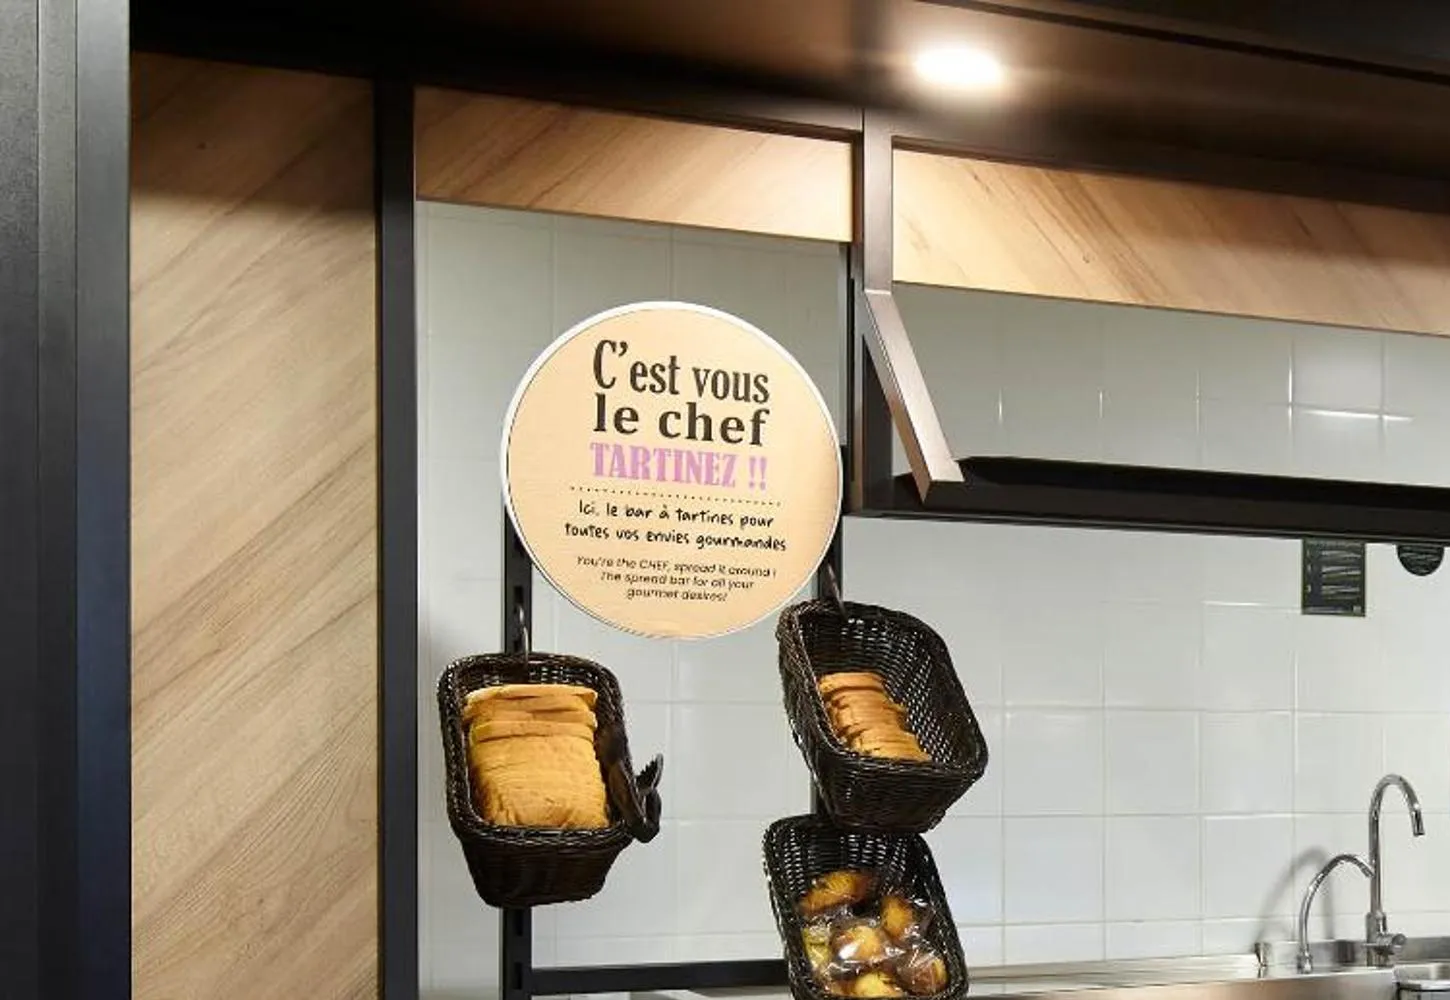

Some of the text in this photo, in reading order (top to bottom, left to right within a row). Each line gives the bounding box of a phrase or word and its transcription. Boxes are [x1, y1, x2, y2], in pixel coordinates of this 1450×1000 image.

[592, 338, 771, 404] C'est vous
[592, 393, 770, 446] le chef
[590, 442, 768, 490] TARTINEZ !!
[606, 502, 618, 517] le
[625, 504, 653, 519] bar
[658, 504, 670, 519] à
[675, 507, 733, 526] tartines
[740, 514, 774, 530] pour
[564, 522, 787, 551] toutes vos envies gourmandes
[624, 572, 667, 585] spread
[669, 574, 691, 586] bar
[674, 562, 716, 575] spread
